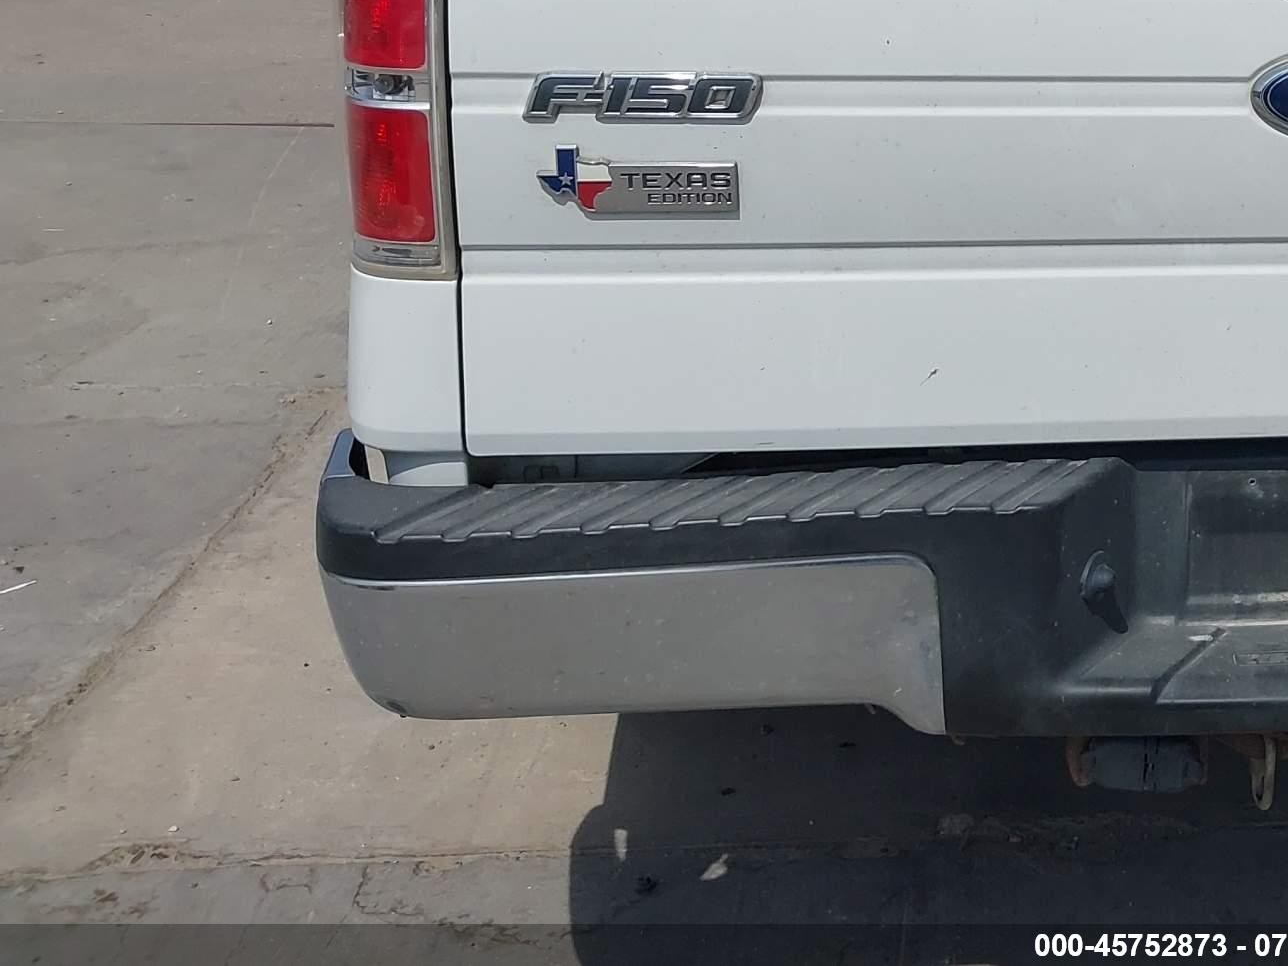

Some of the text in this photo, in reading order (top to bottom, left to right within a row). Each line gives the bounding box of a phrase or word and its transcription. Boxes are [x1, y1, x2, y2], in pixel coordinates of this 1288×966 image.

[522, 71, 764, 124] F-150
[620, 172, 732, 189] TEXAS
[647, 192, 733, 204] EDITION
